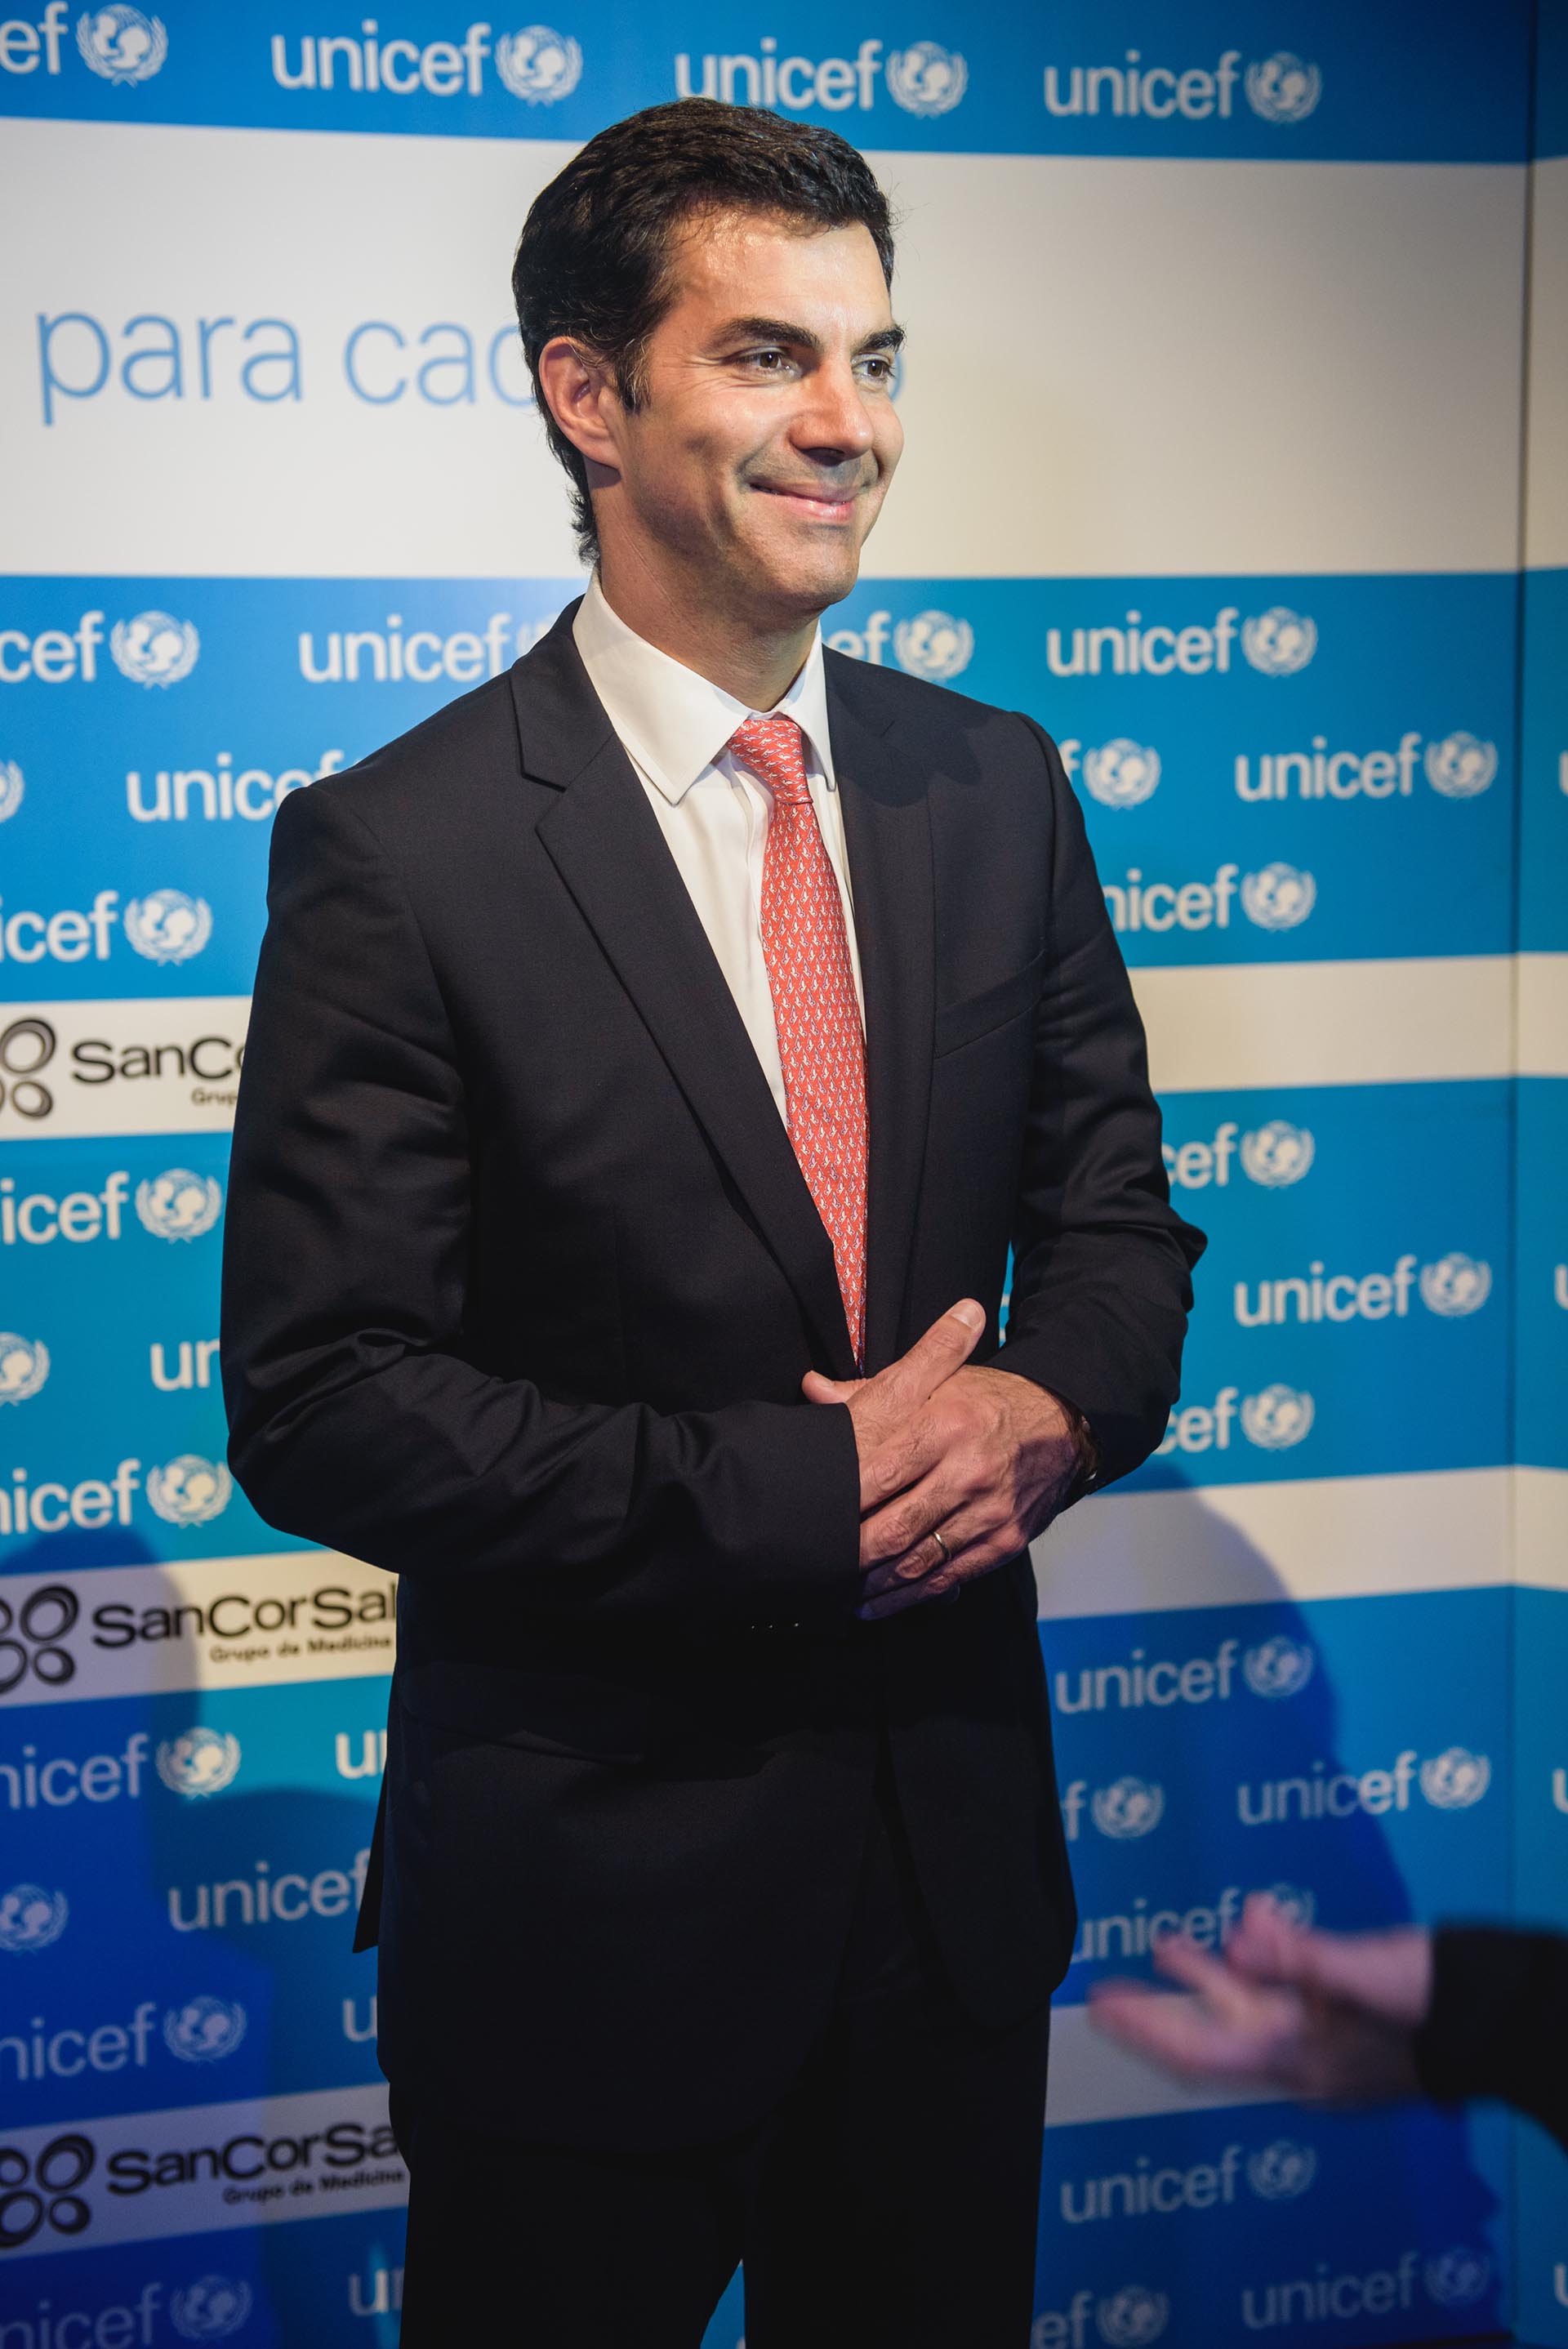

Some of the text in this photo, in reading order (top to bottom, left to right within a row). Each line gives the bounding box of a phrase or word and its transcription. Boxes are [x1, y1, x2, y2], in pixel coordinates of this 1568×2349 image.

[271, 20, 490, 97] unicef
[675, 38, 883, 111] unicef
[1043, 49, 1242, 119] unicef
[37, 311, 304, 427] para
[0, 611, 105, 683] cef
[298, 613, 511, 683] unicef
[1046, 608, 1239, 677] unicef
[1235, 732, 1422, 802] unicef
[1102, 863, 1239, 933] nicef
[0, 1170, 131, 1245] icef
[1234, 1255, 1417, 1327] unicef
[91, 1581, 398, 1650] SanCorSal
[1055, 1640, 1240, 1714] unicef
[0, 1732, 149, 1809] nicef
[1237, 1749, 1419, 1825] unicef
[0, 2001, 157, 2080] nicef
[106, 2122, 399, 2195] SanCorSa
[1061, 2145, 1243, 2224] unicef
[0, 2281, 163, 2349] nicef
[1241, 2250, 1419, 2330] unicef
